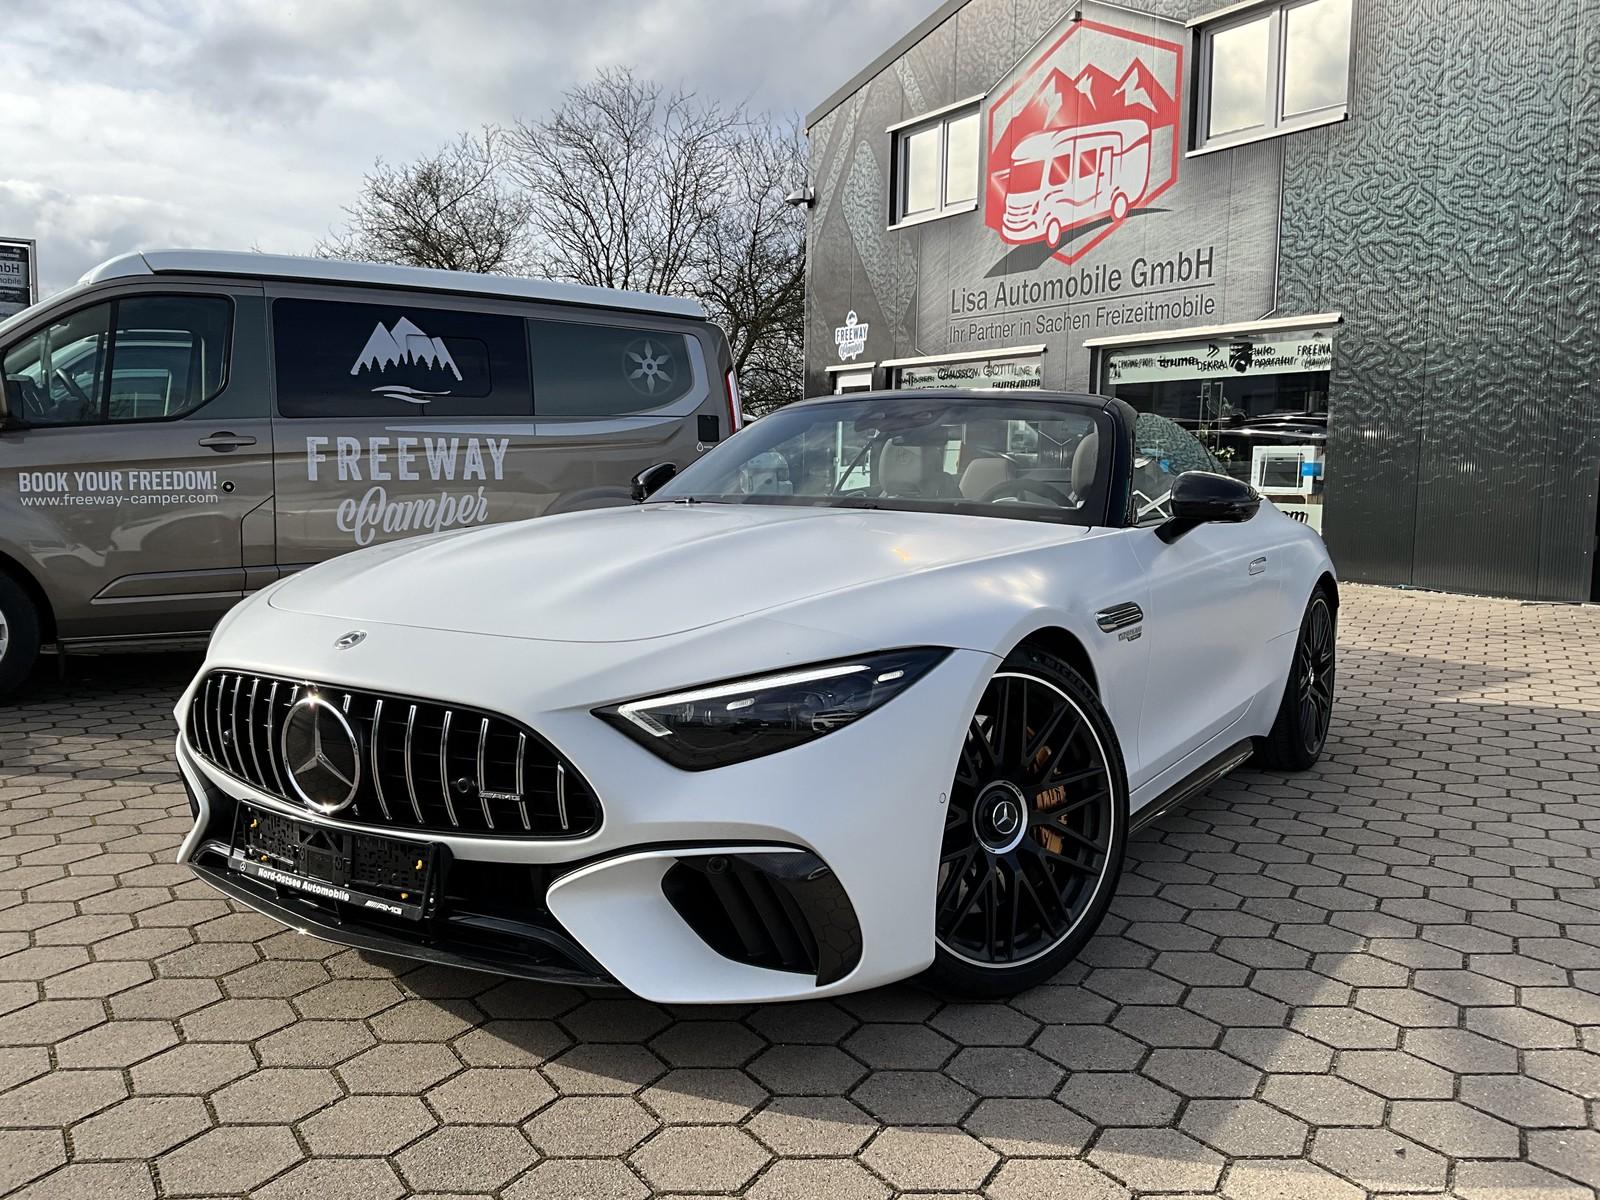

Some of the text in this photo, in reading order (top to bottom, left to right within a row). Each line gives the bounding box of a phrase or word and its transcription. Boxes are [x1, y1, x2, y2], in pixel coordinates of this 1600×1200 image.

[951, 246, 1214, 314] Lisa Automobile GmbH
[949, 294, 1215, 344] Ihr Partner in Sachen Freizeitmobile
[836, 325, 867, 342] FREEWAY
[1197, 359, 1228, 372] DEKRA
[306, 436, 510, 481] FREEWAY
[18, 471, 218, 492] BOOK YOUR FREEDOM!
[20, 493, 219, 507] www.freeway-camper.com
[336, 486, 488, 546] Camper
[257, 867, 350, 901] Nord-Ostsee Automobile
[373, 902, 402, 915] AMG
